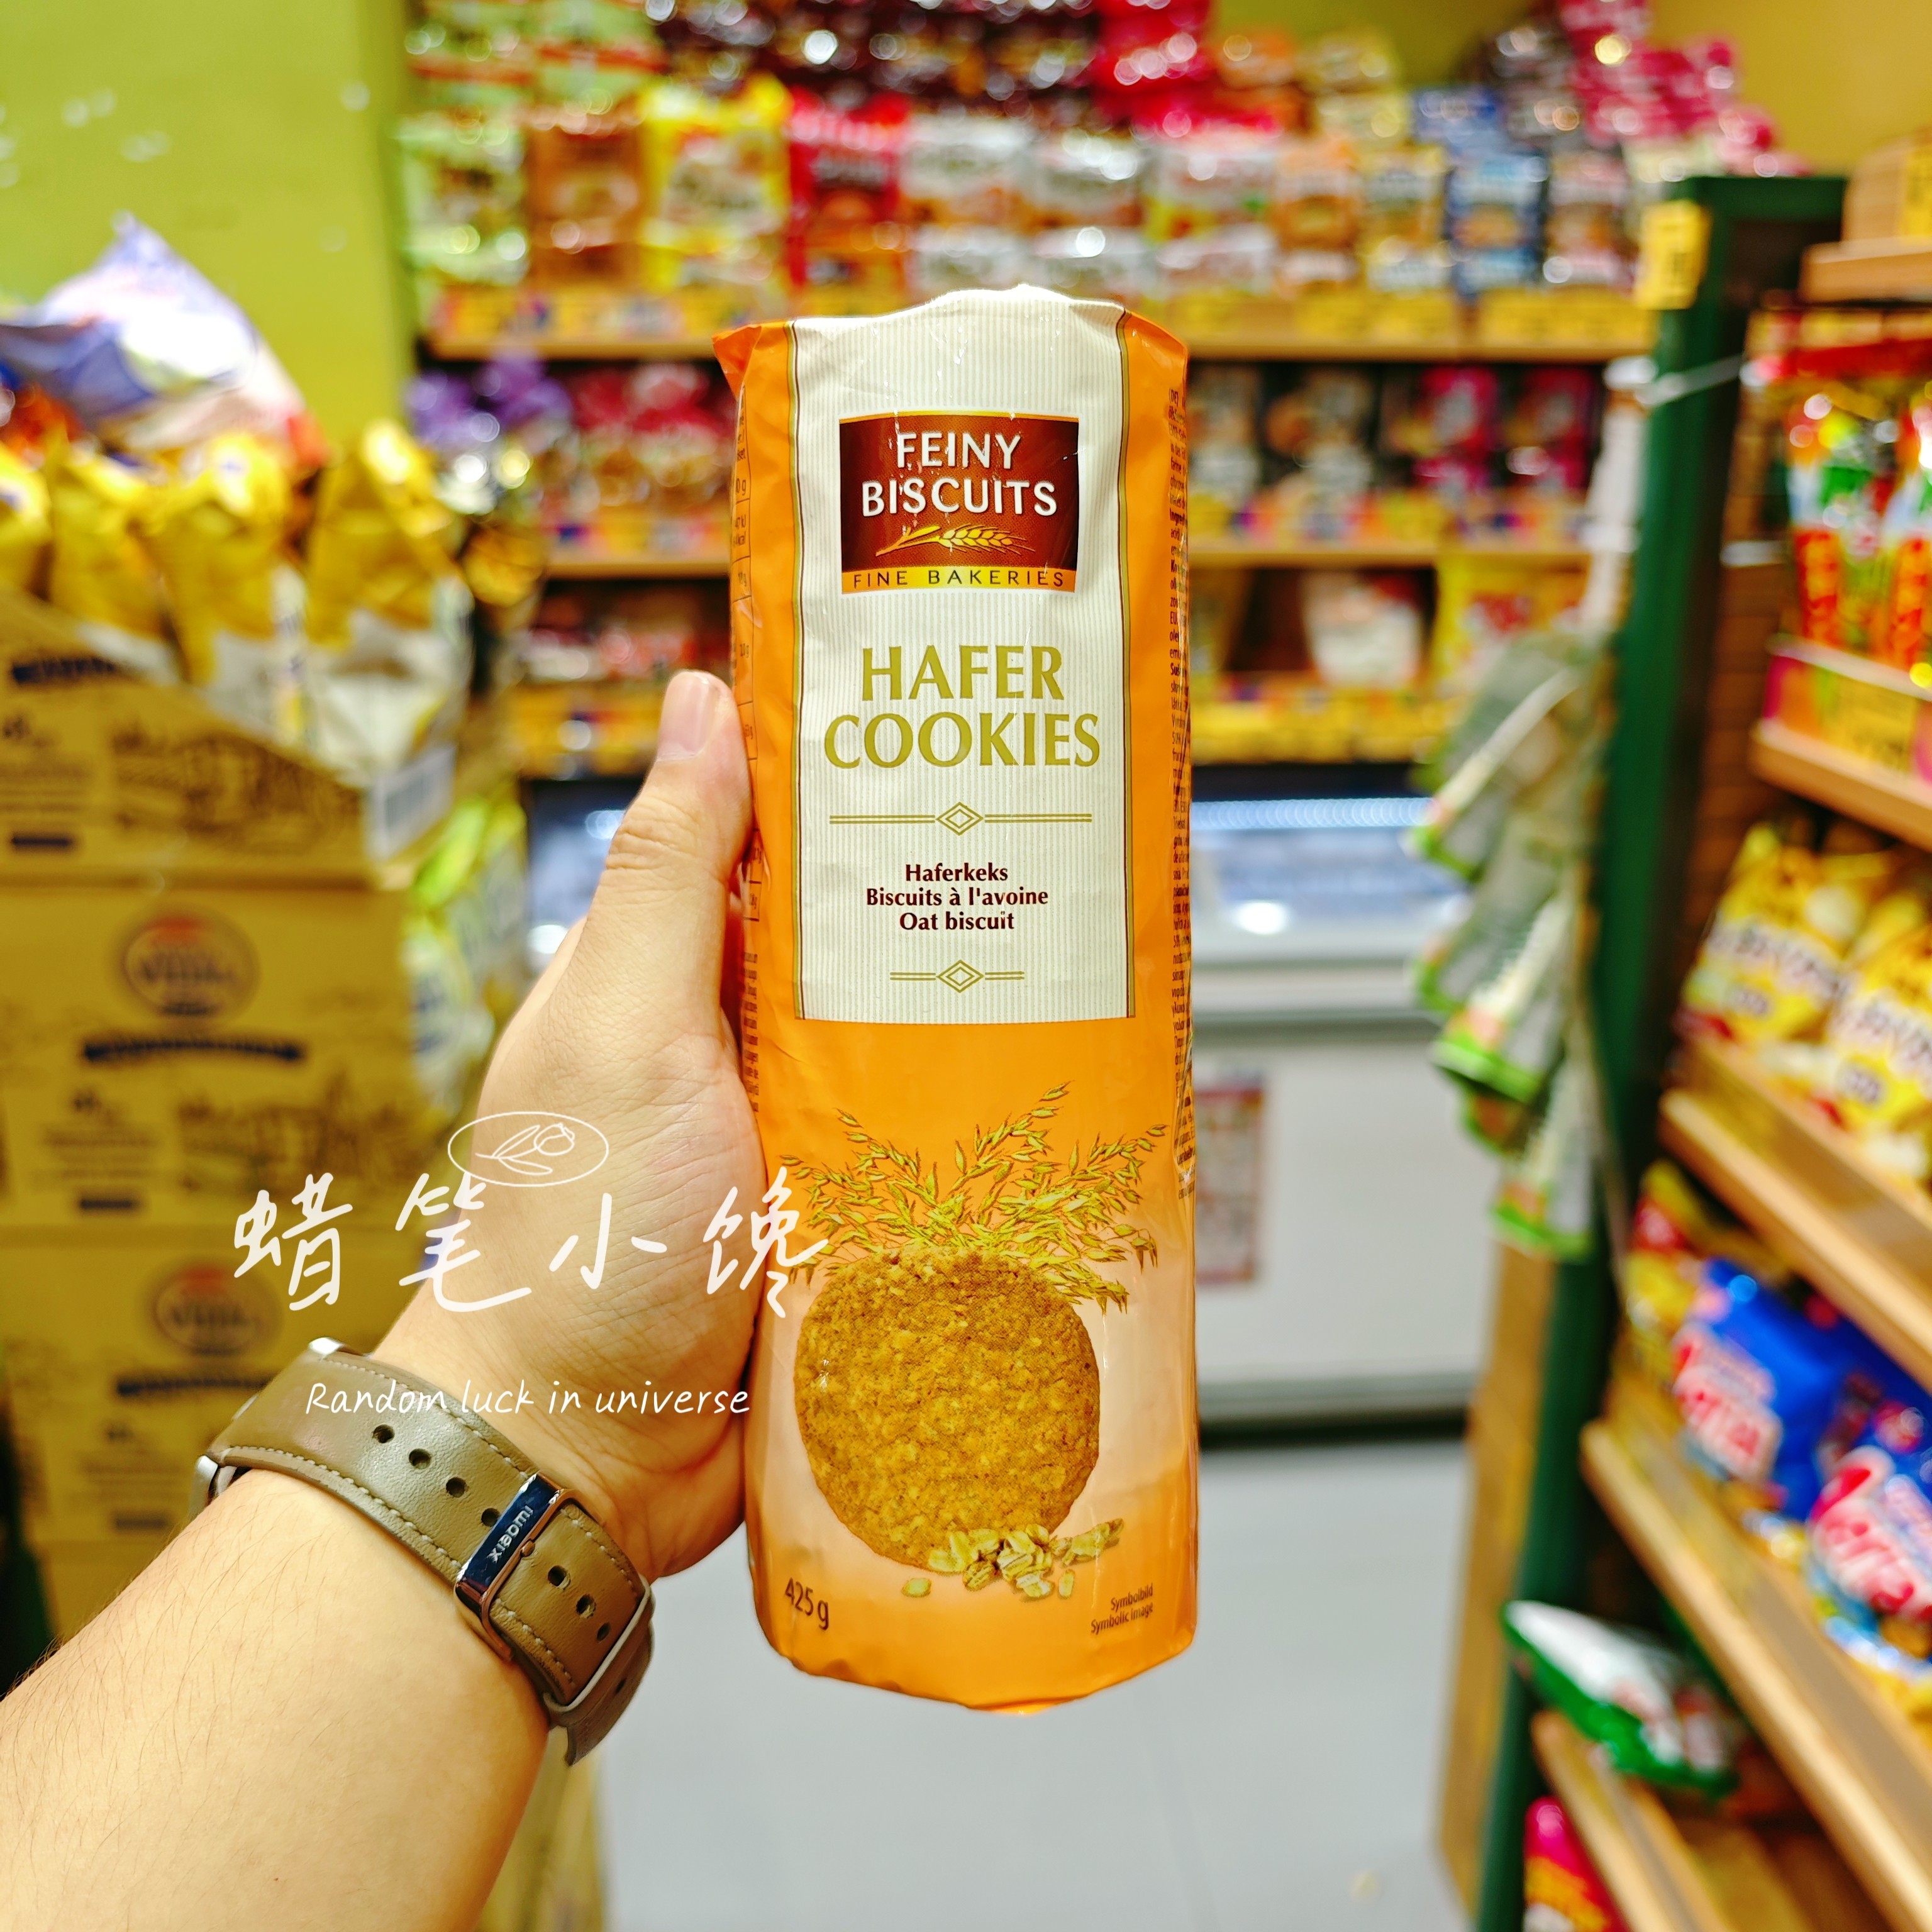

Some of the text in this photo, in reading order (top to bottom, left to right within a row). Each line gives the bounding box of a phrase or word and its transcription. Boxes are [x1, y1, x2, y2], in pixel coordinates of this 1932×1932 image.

[896, 431, 1021, 469] FEINY
[862, 477, 1057, 517] BISCUITS
[853, 569, 1064, 589] FINE BAKERIES
[862, 645, 1064, 701] HAFER
[824, 711, 1100, 769] COOKIES
[906, 862, 1008, 881] Haferkeks
[867, 886, 1048, 906] Biscuits à l'avoine
[899, 911, 1015, 931] Oat biscuit
[784, 1577, 829, 1631] 425 g
[1110, 1582, 1153, 1613] Symbolbild
[1091, 1602, 1153, 1635] Symbolic image
